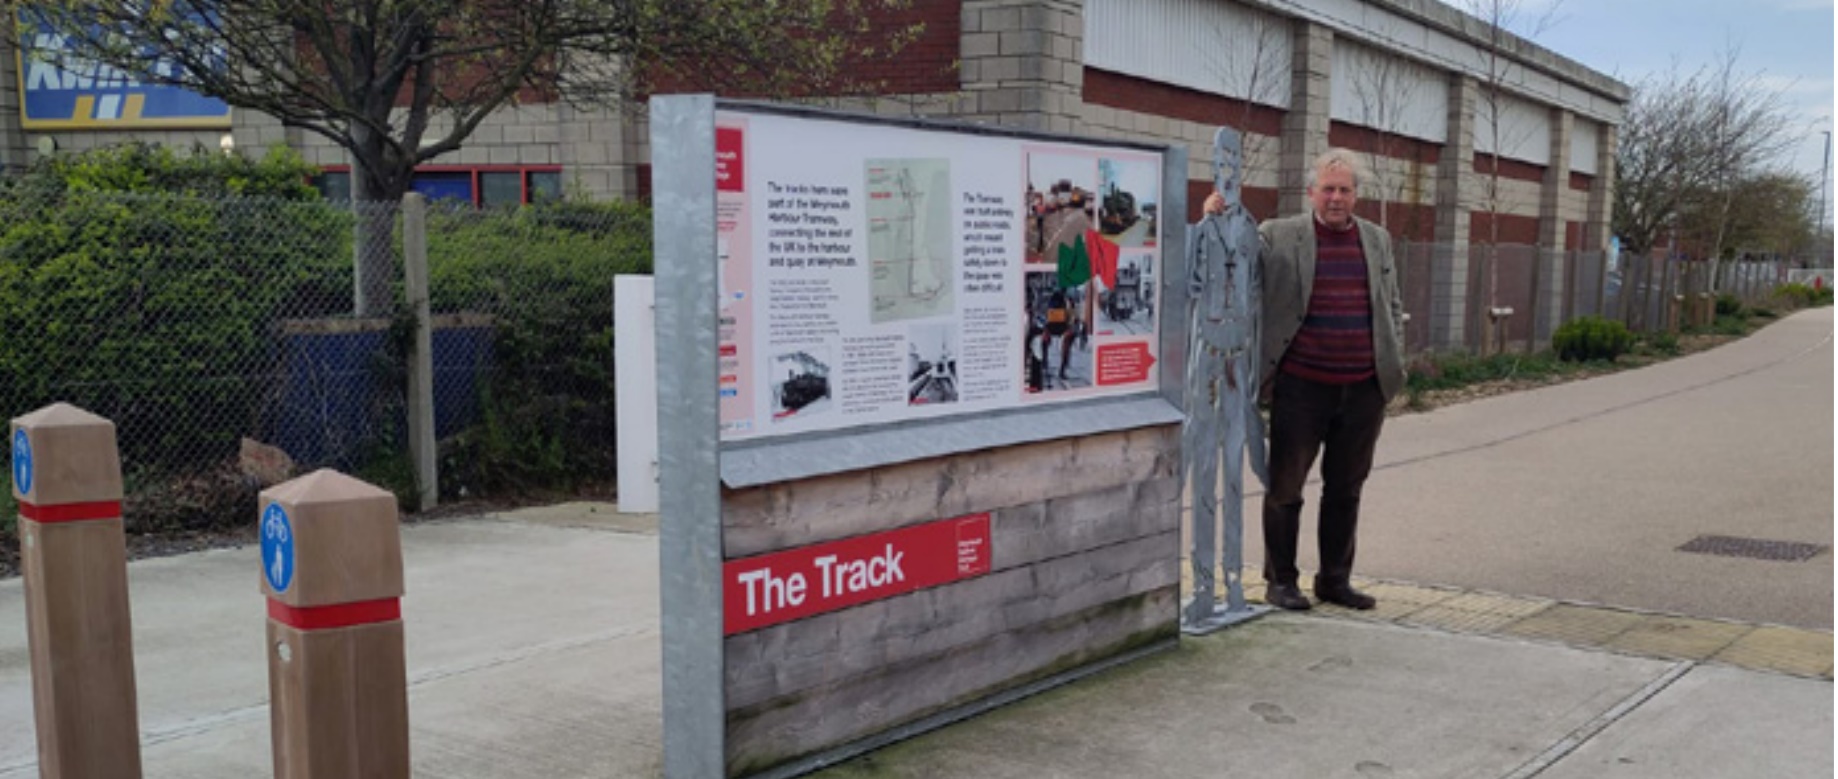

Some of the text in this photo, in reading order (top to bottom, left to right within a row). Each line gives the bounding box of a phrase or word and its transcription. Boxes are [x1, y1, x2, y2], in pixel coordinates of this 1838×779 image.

[796, 199, 808, 209] the
[810, 199, 850, 211] Weymouth
[768, 229, 813, 240] connecting
[815, 229, 827, 238] the
[769, 242, 781, 253] the
[807, 242, 819, 253] the
[769, 257, 784, 267] and
[737, 543, 904, 616] The Track
